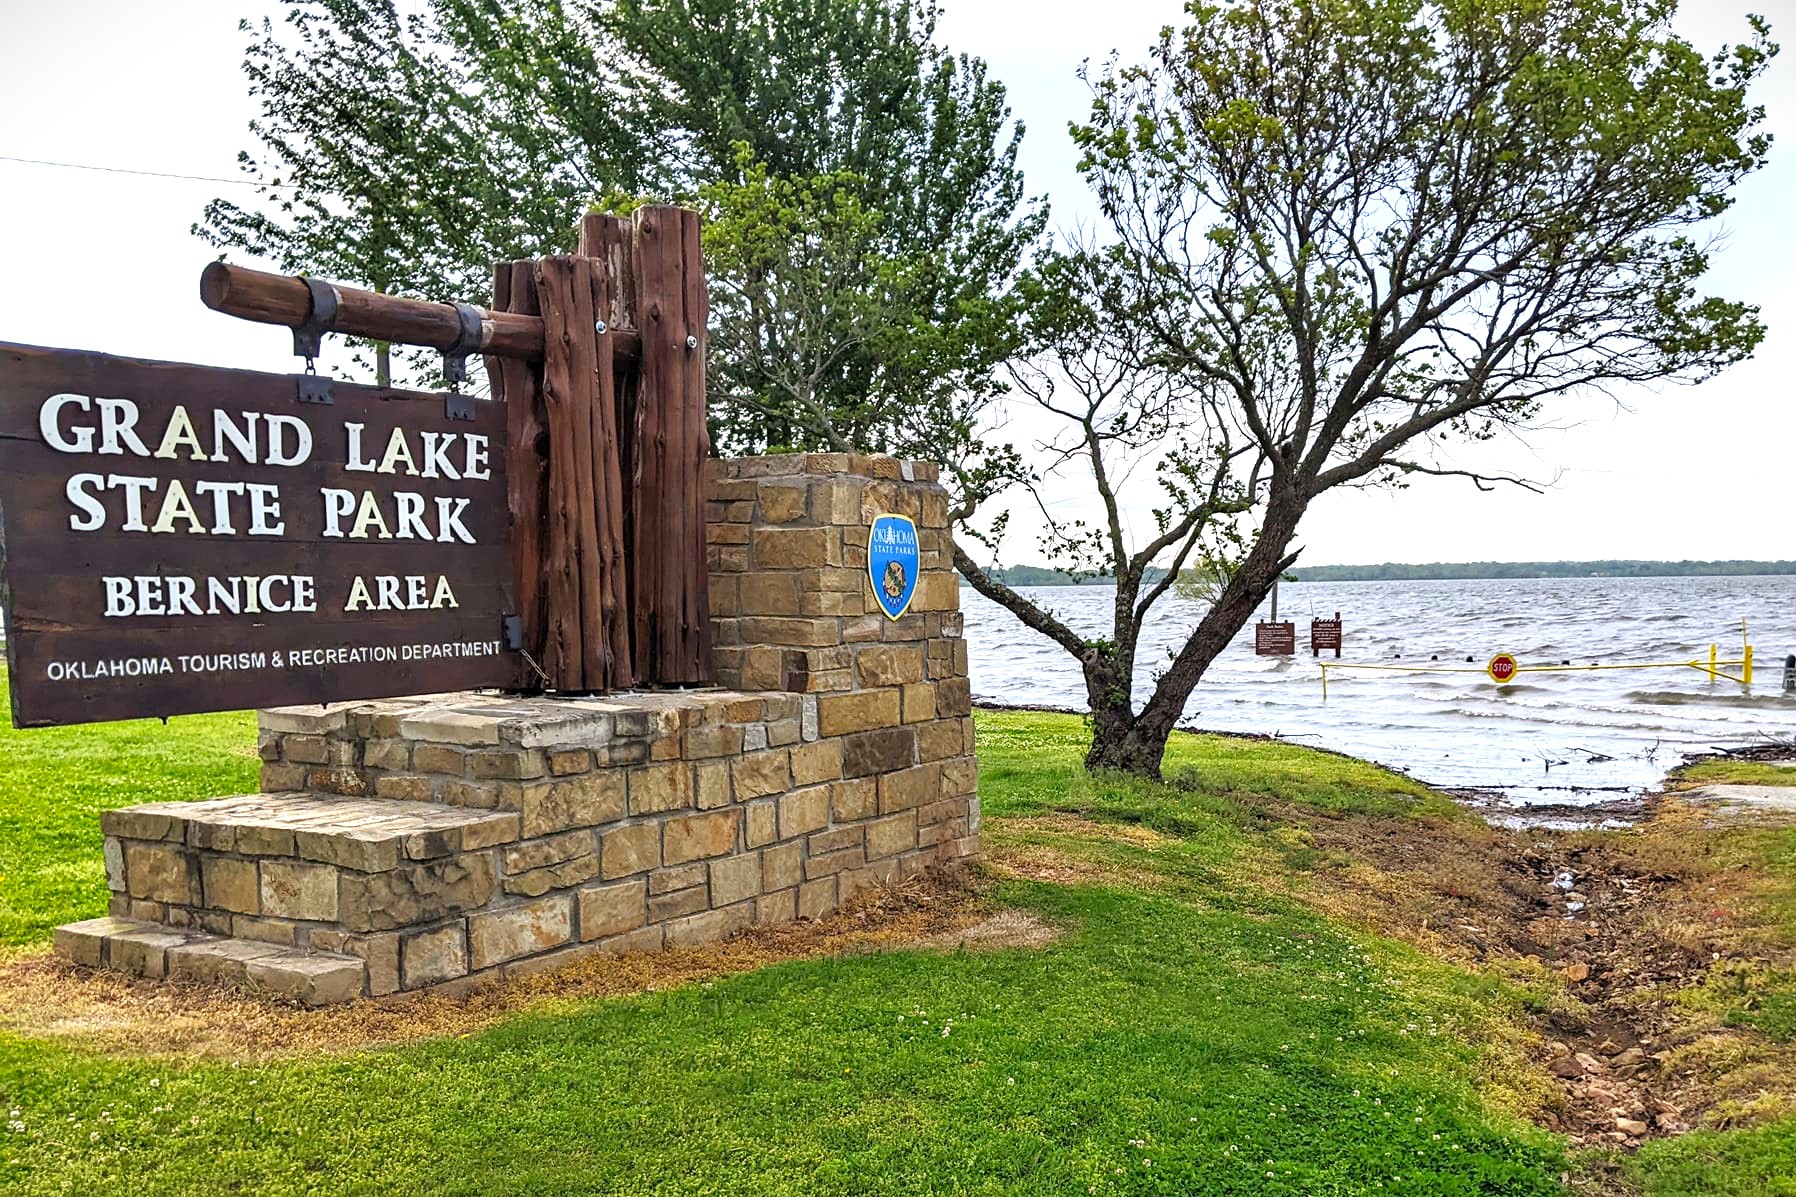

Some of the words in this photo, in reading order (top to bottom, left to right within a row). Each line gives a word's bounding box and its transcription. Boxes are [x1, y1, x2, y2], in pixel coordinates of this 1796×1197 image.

[39, 393, 313, 467] GRAND
[344, 421, 491, 481] LAKE
[66, 473, 286, 536] STATE
[321, 487, 477, 544] PARK
[874, 545, 893, 554] STATE
[895, 546, 915, 555] PARKS
[102, 574, 318, 617] BERNICE
[344, 575, 459, 612] AREA
[47, 657, 174, 681] OKLAHOMA
[178, 652, 266, 673] TOURISM
[271, 650, 284, 668] &
[289, 646, 398, 666] RECREATION
[402, 640, 501, 661] DEPARTMENT
[1493, 663, 1513, 672] STOP
